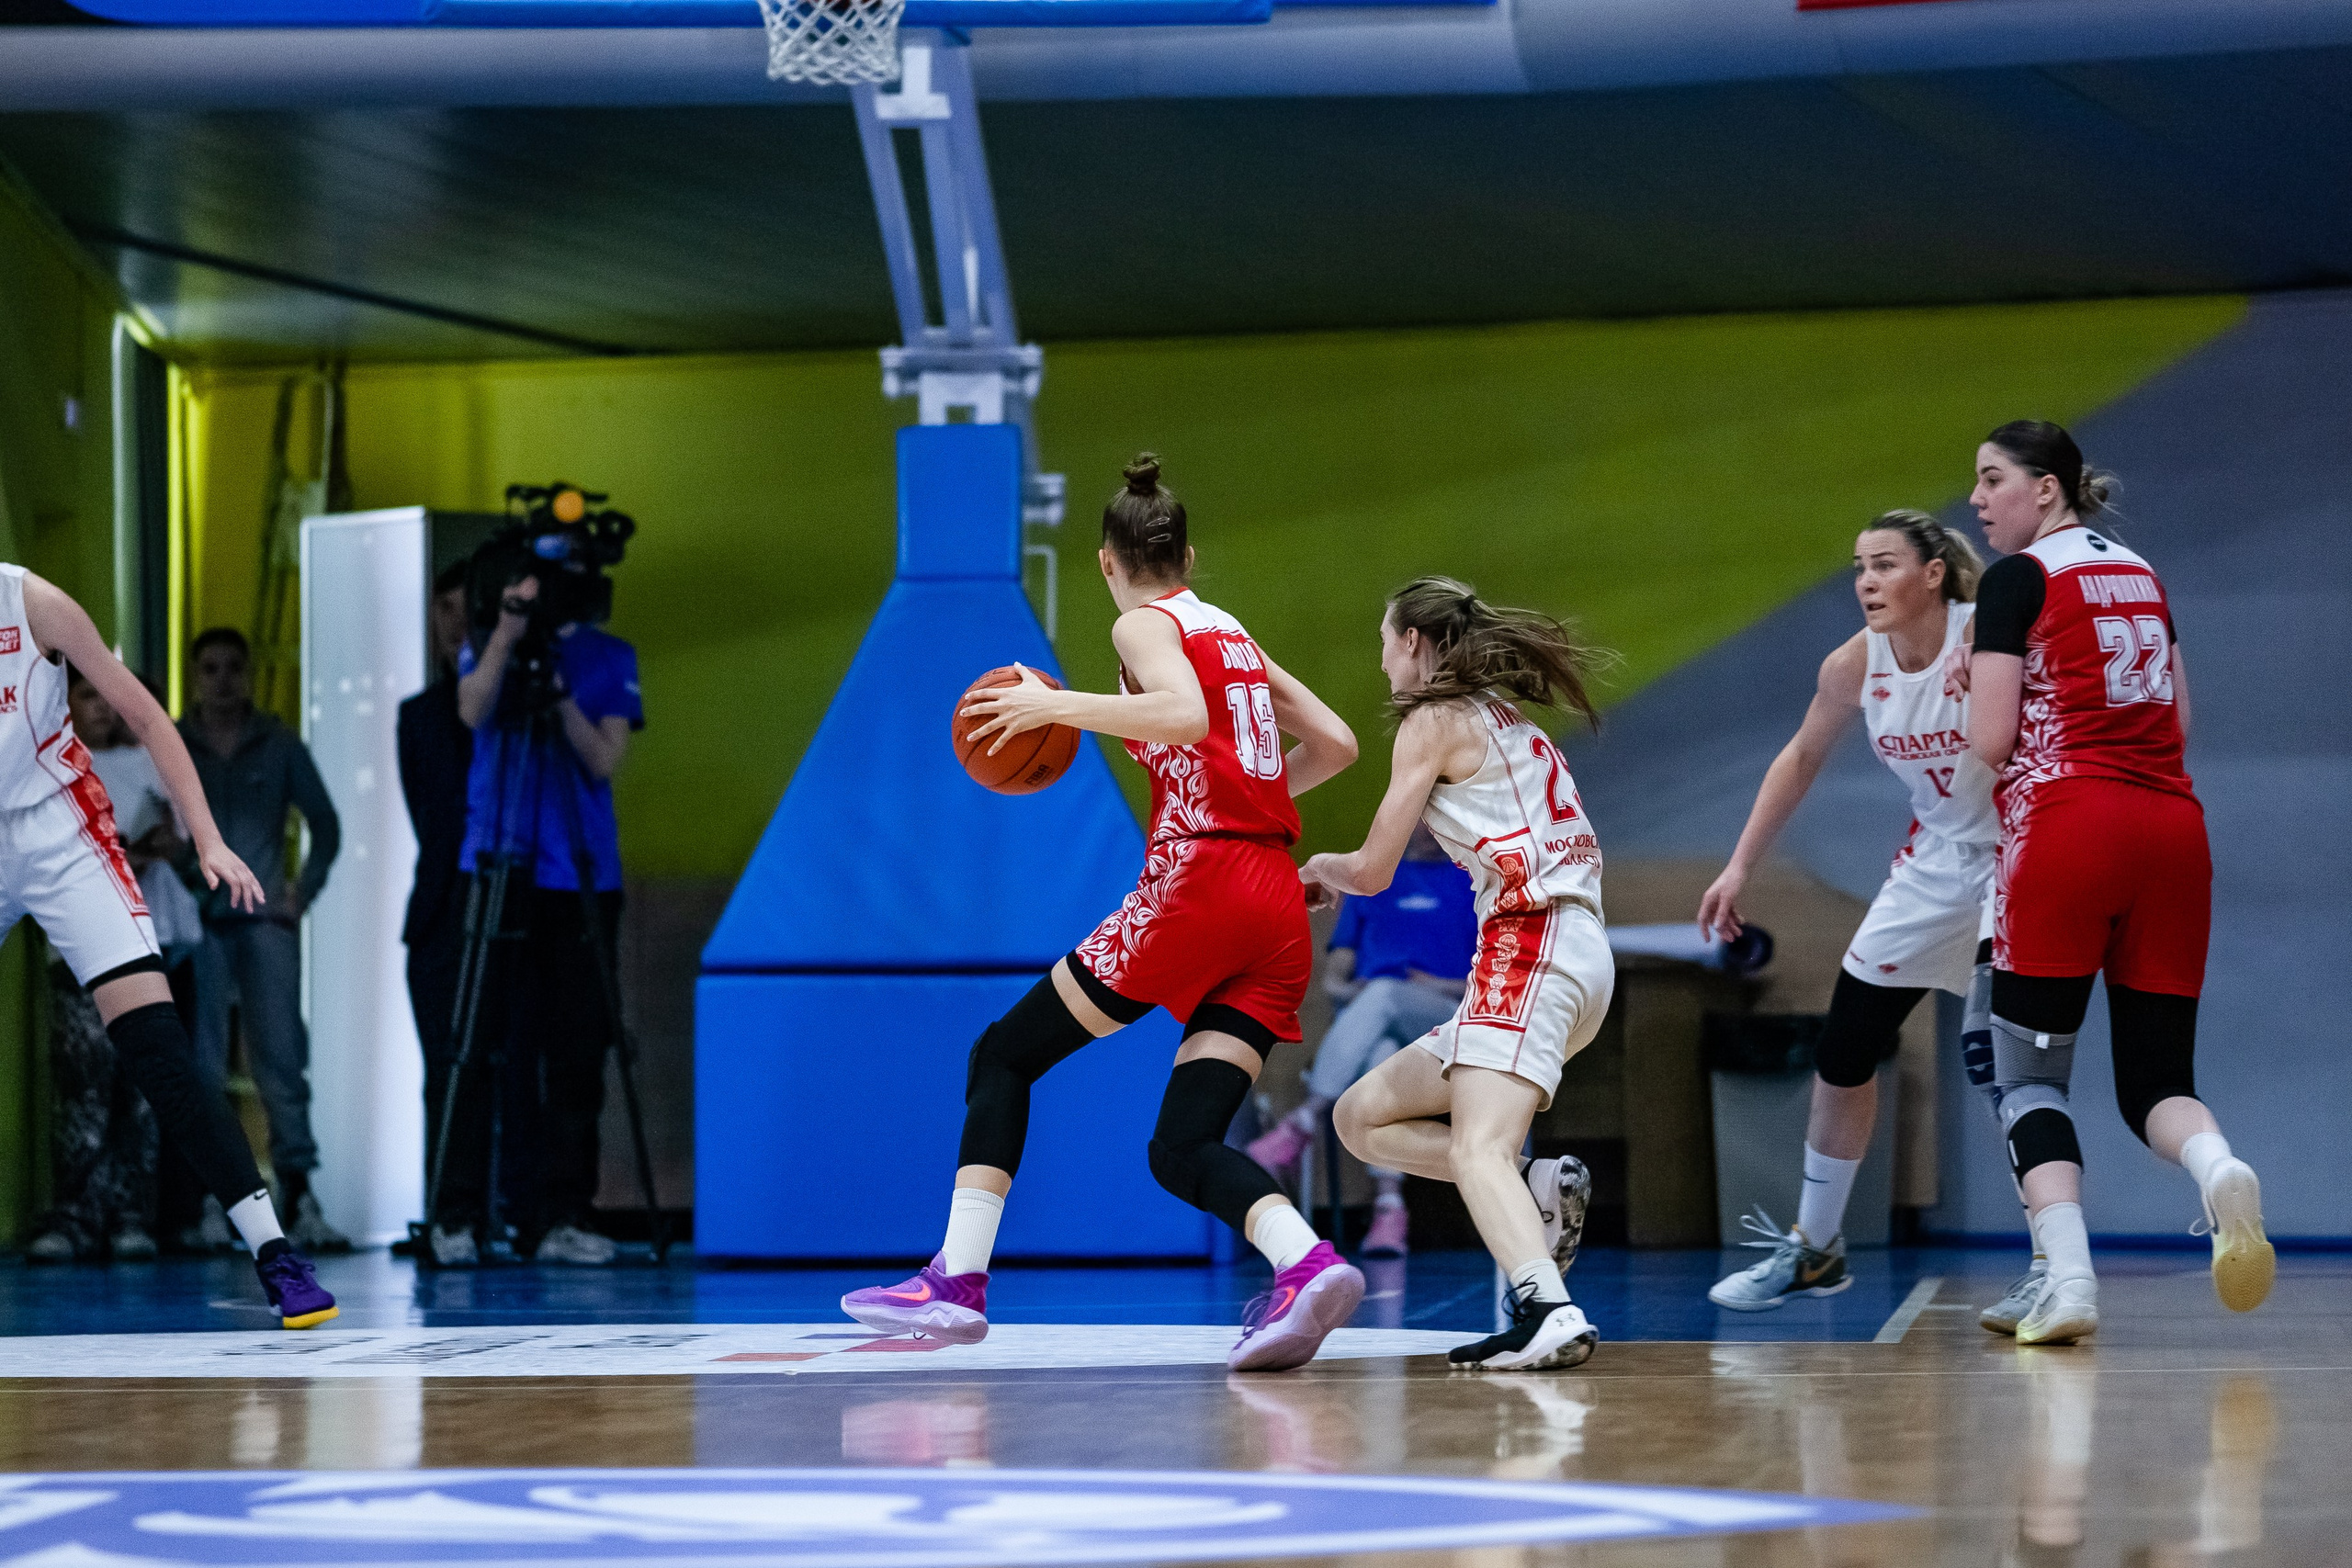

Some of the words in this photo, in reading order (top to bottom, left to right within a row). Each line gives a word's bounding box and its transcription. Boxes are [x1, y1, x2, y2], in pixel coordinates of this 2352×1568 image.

[2093, 615, 2174, 707] 22
[1225, 682, 1283, 781] 15
[1878, 729, 1967, 752] СПАРТА
[1023, 763, 1049, 785] FIBA
[1529, 735, 1583, 825] 2
[1544, 834, 1599, 854] МОСКОВС
